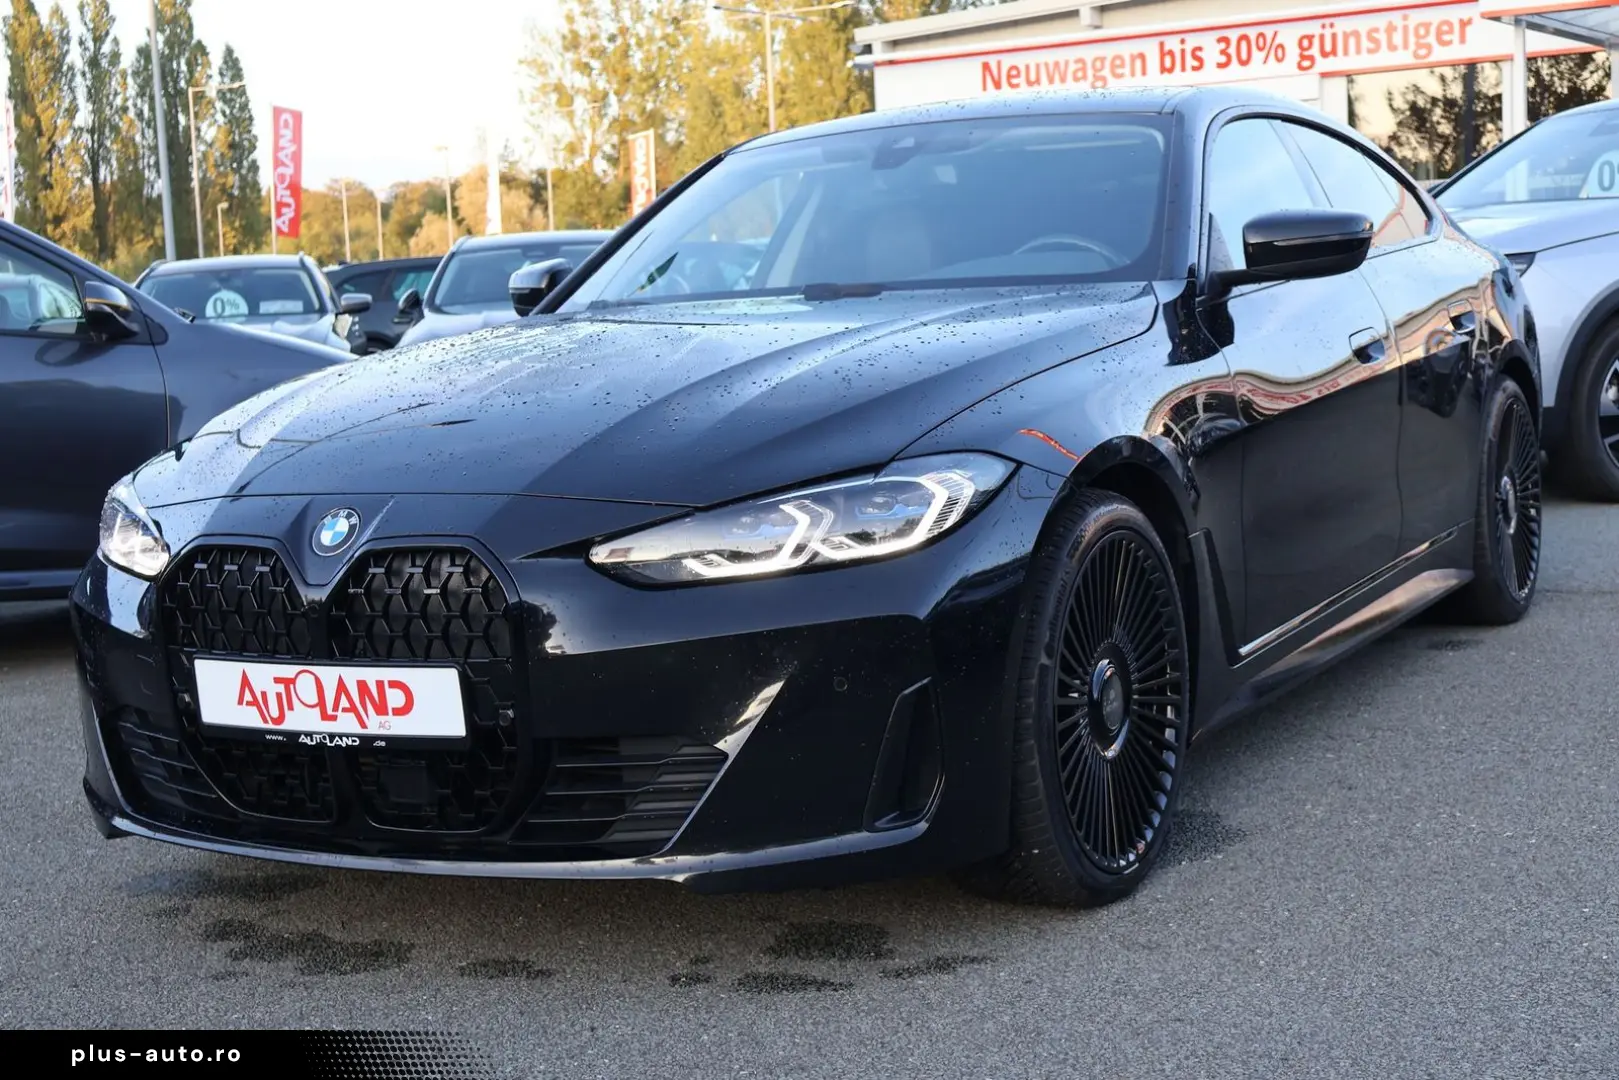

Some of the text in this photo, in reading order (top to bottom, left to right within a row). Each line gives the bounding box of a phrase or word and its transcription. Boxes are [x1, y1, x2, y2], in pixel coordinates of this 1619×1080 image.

[981, 14, 1474, 92] Neuwagen bis 30% günstiger
[275, 111, 297, 233] AUTOLAND
[1597, 160, 1619, 192] 0
[212, 297, 240, 317] 0%
[323, 510, 358, 525] BMW
[237, 668, 415, 730] AUTOLAND
[377, 720, 392, 731] AG
[298, 733, 360, 747] AUTOLAND
